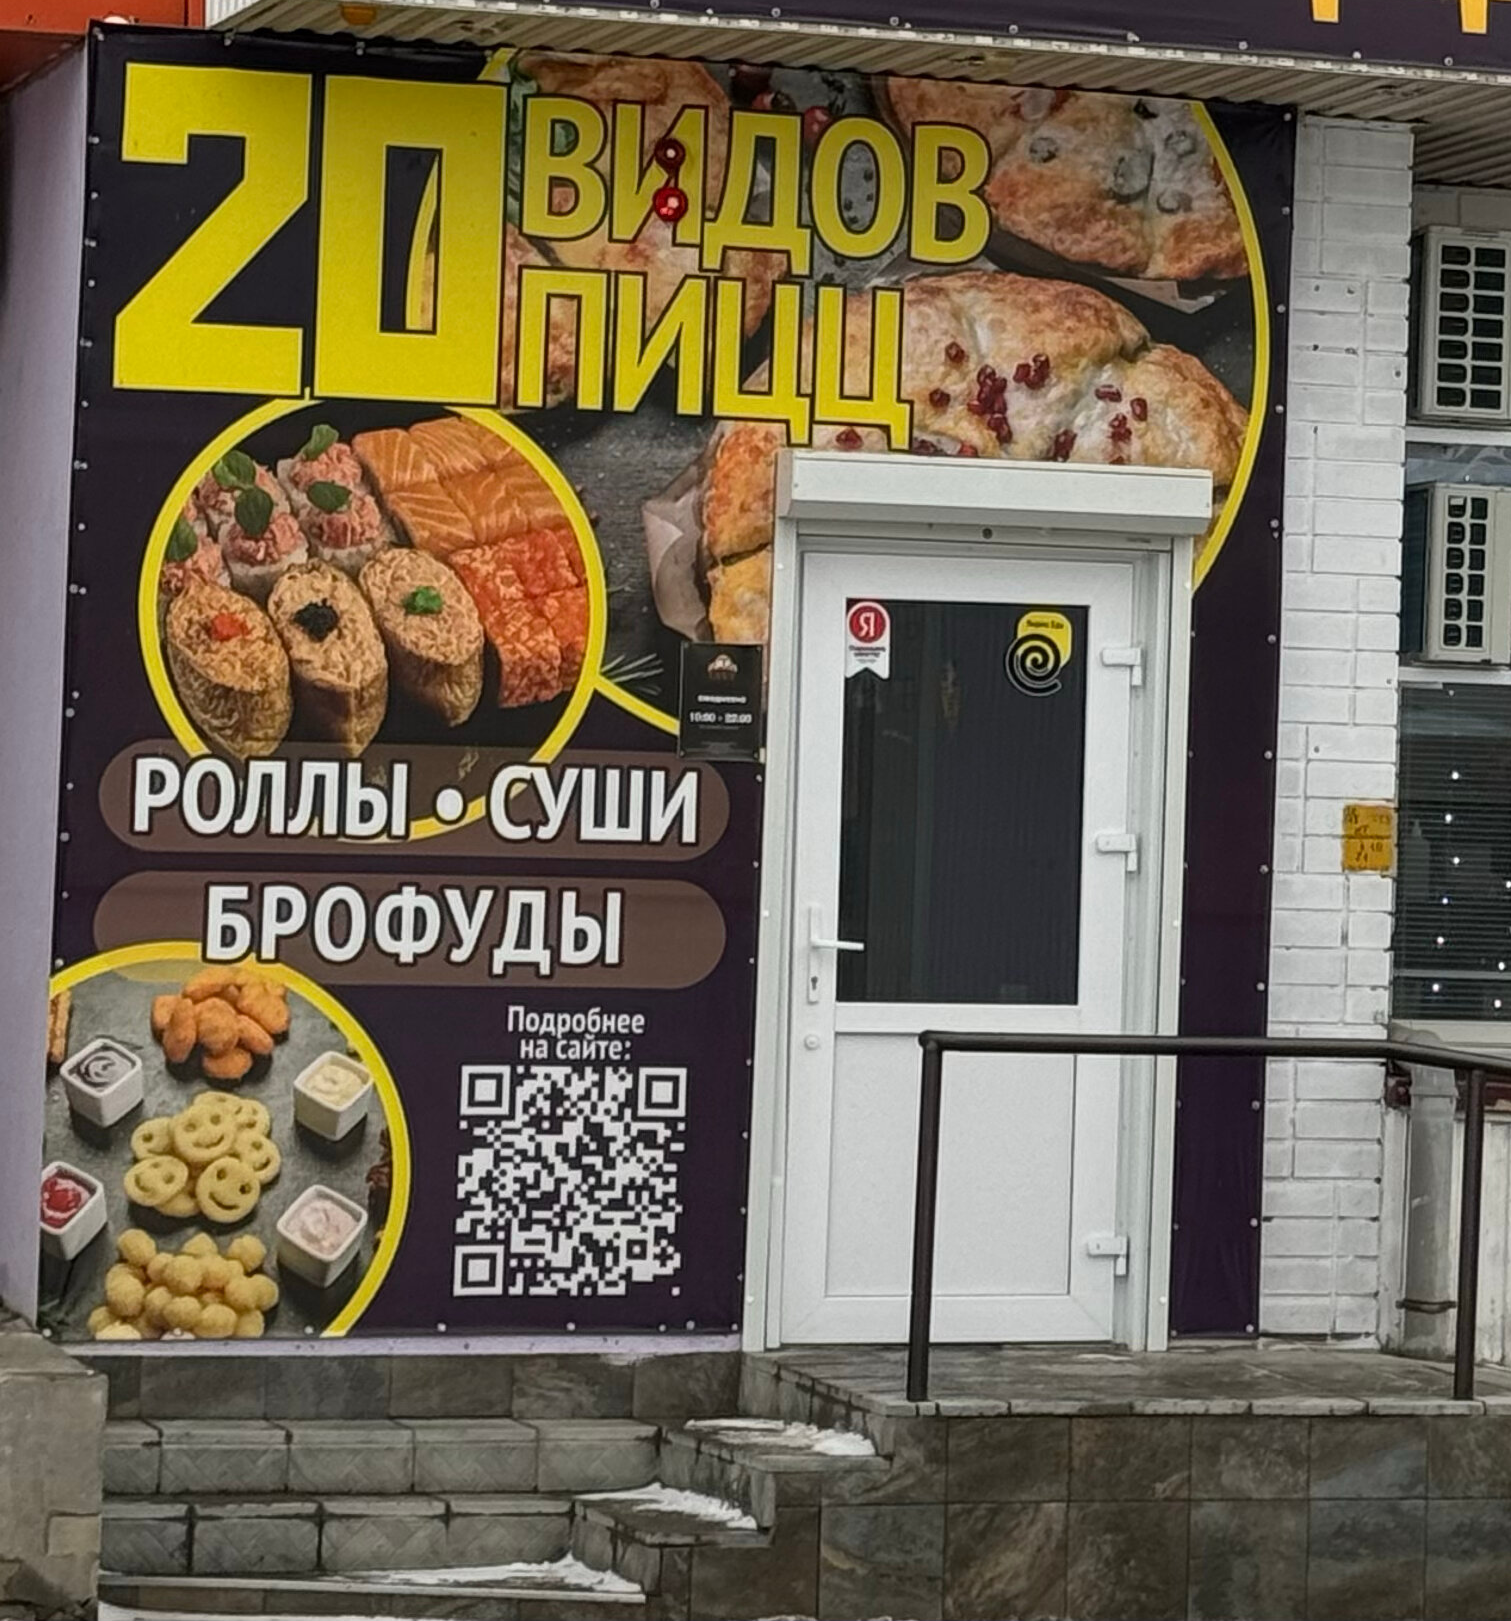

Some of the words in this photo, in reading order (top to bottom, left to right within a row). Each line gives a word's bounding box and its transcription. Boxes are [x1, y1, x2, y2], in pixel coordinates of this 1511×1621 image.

[521, 96, 989, 273] ВИДОВ
[114, 63, 507, 404] 20
[517, 271, 911, 450] ПИЦЦ
[859, 611, 875, 637] Я
[132, 757, 406, 837] РОЛЛЫ
[489, 766, 699, 844] СУШИ
[203, 884, 621, 977] БРОФУДЫ
[507, 1005, 645, 1039] Подробнее
[520, 1039, 548, 1059] на
[556, 1034, 632, 1061] сайте:
